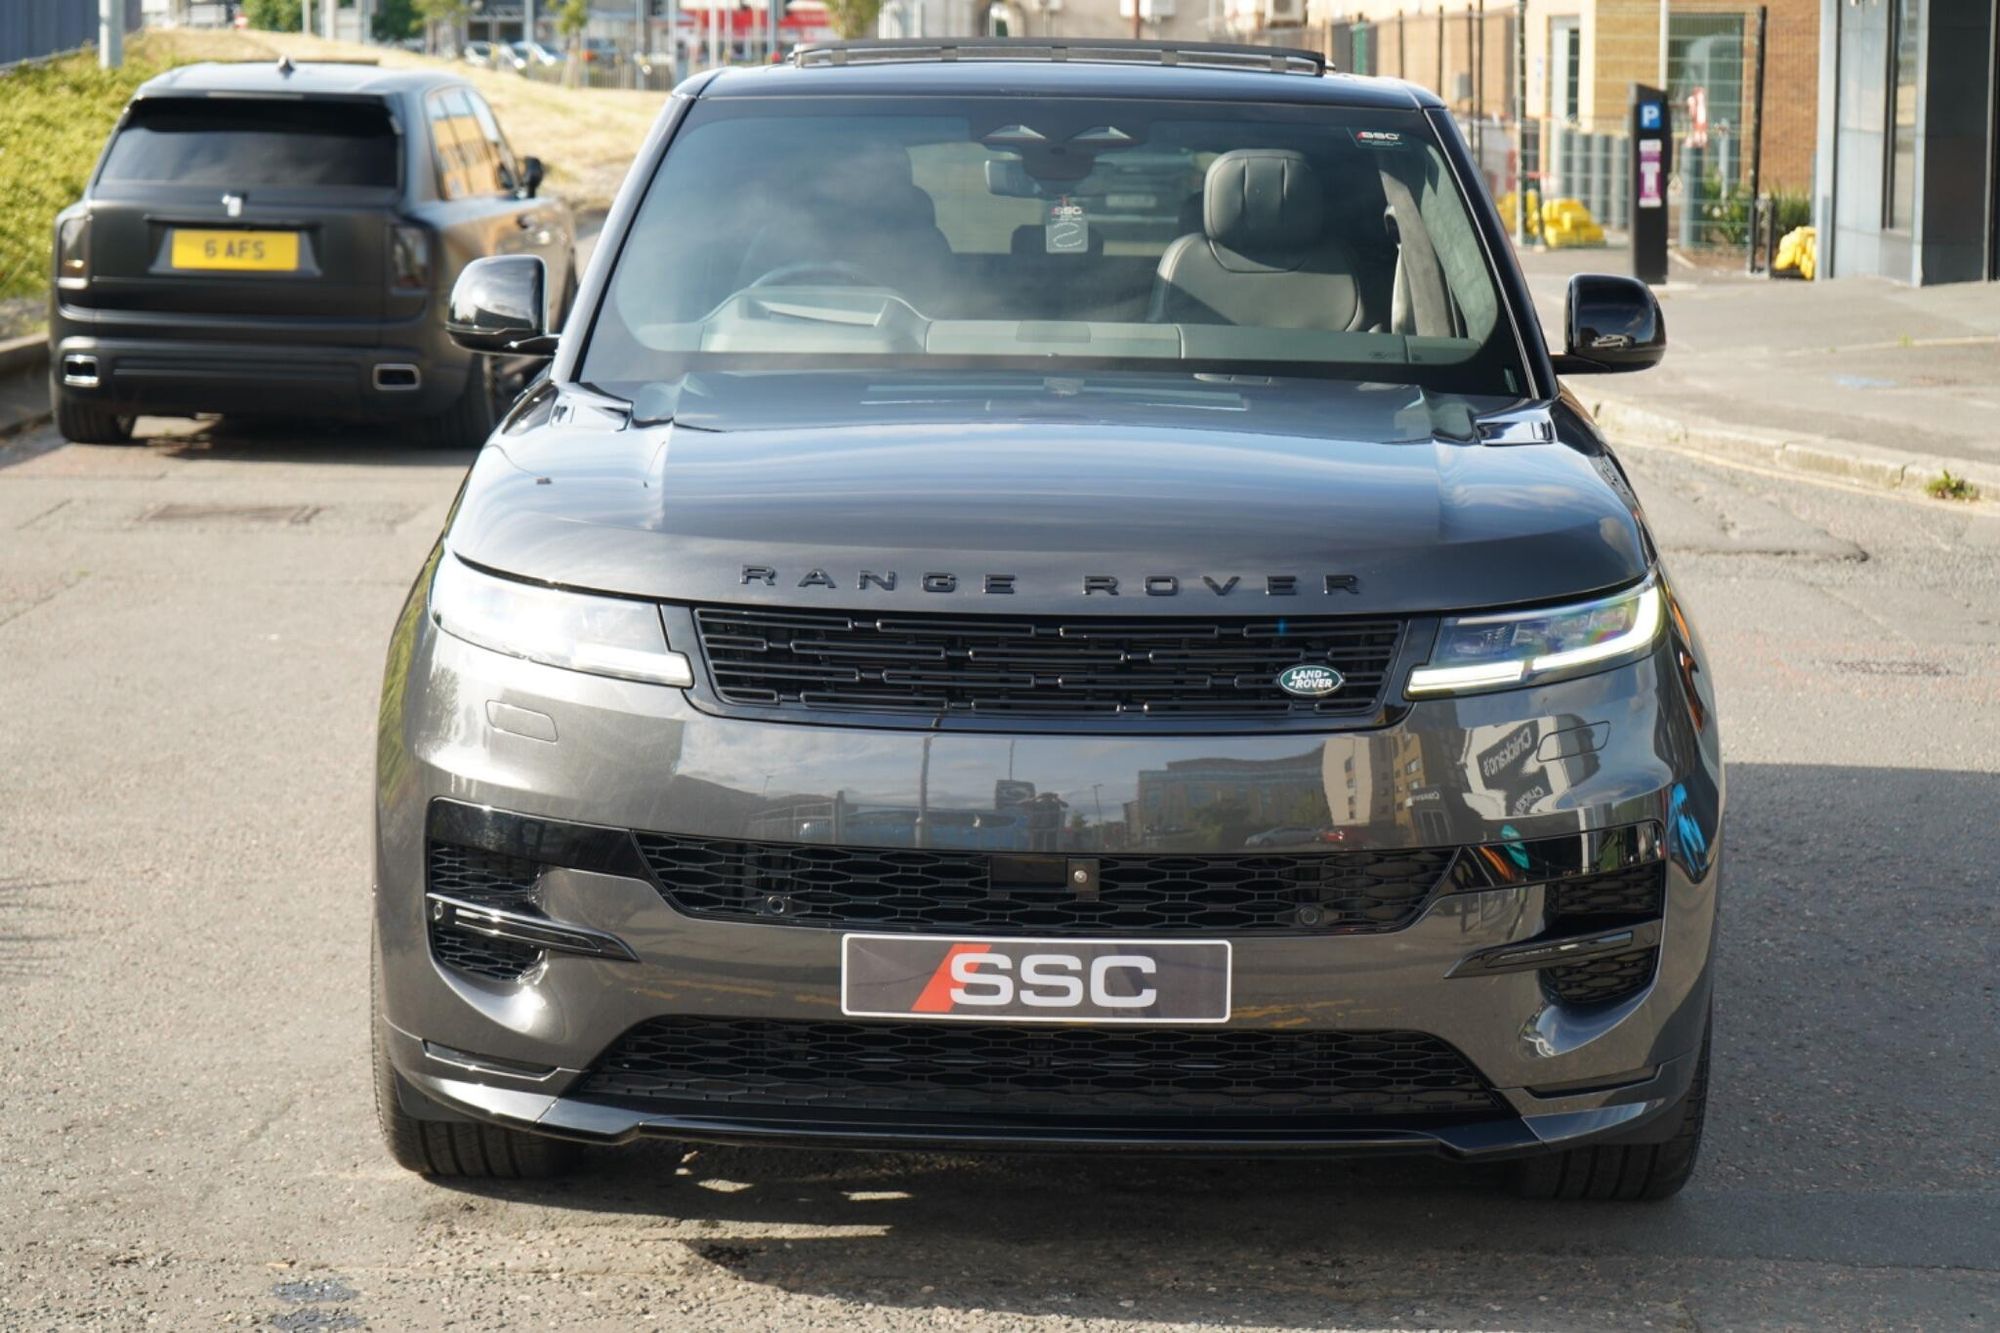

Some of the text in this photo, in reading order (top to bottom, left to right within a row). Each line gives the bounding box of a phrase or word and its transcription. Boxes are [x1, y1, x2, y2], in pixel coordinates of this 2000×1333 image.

[1641, 104, 1660, 128] P
[204, 238, 265, 259] 6 AFS
[740, 564, 1360, 596] RANGE ROVER
[1291, 670, 1322, 680] LAND
[1295, 678, 1333, 689] ROVER
[950, 953, 1157, 1008] SSC
